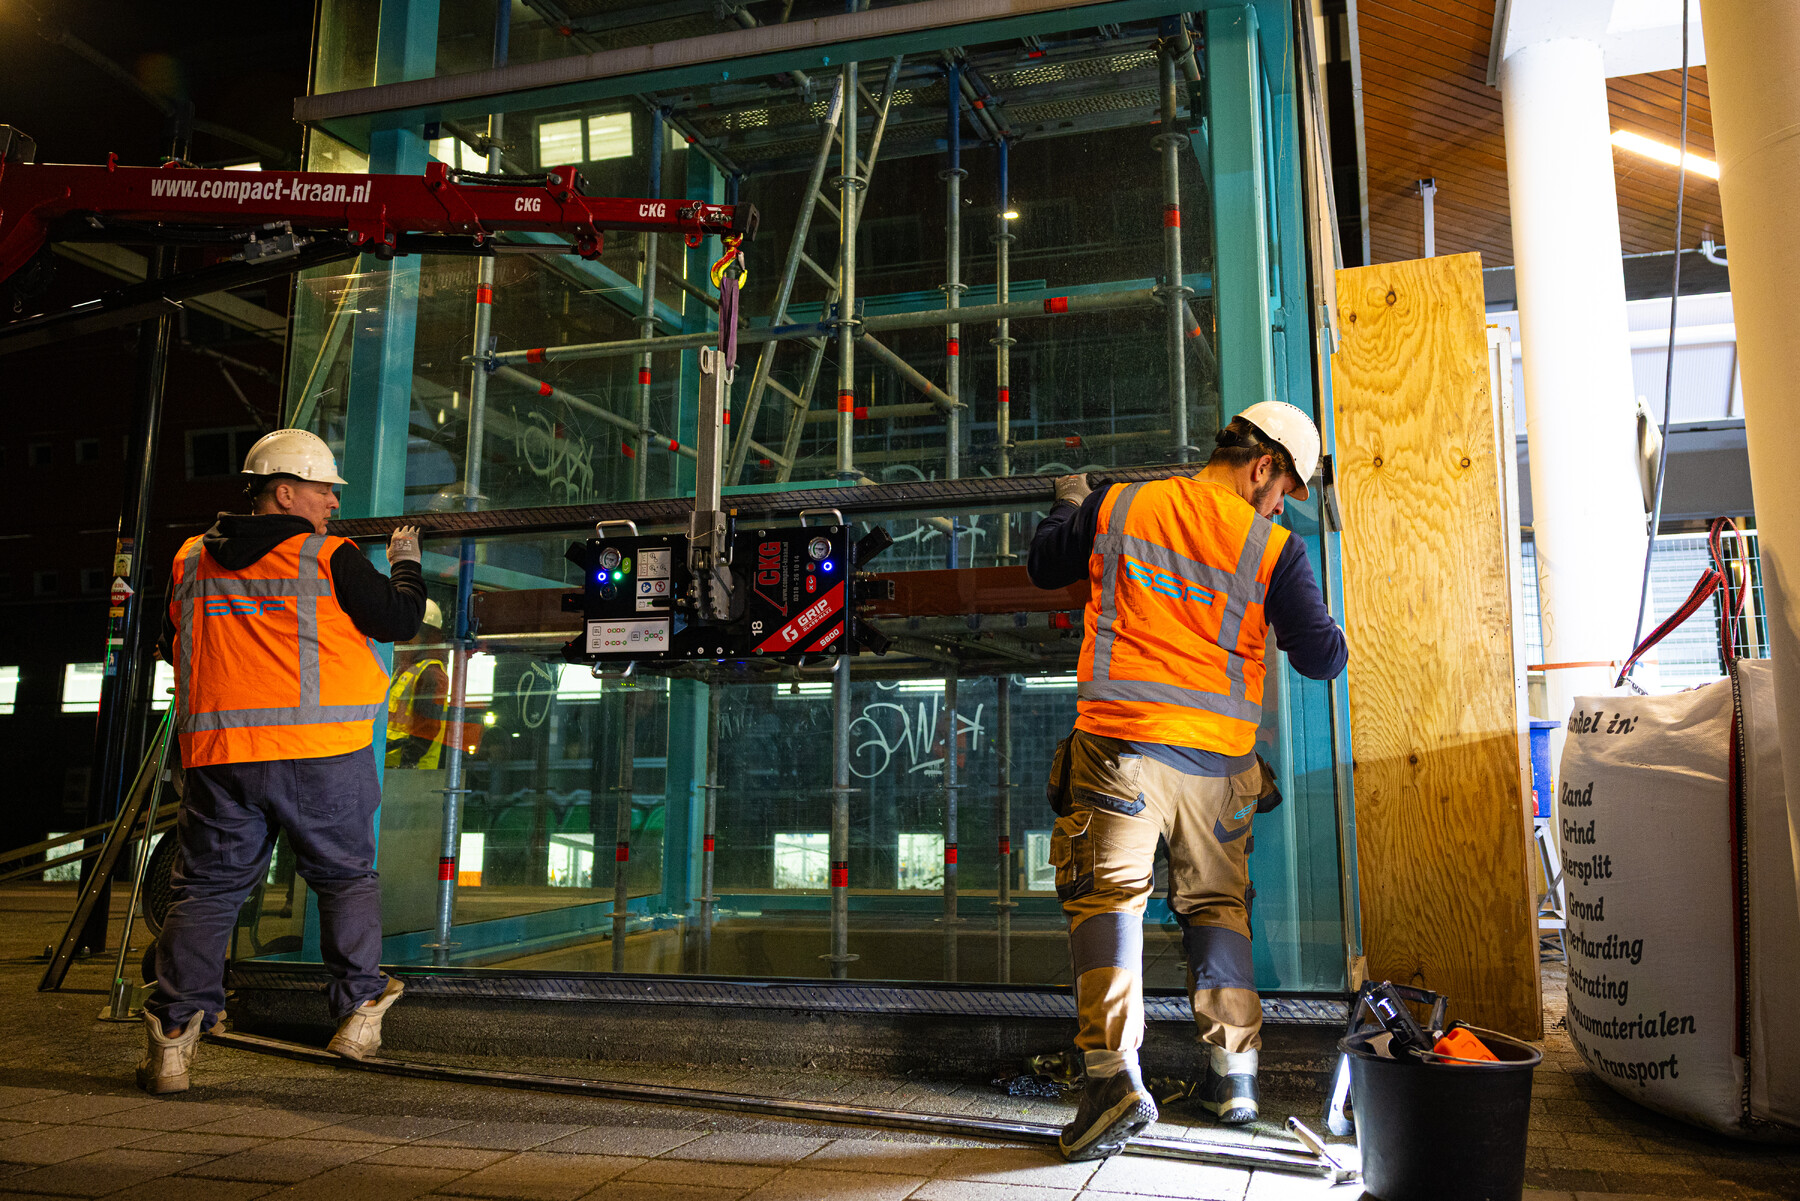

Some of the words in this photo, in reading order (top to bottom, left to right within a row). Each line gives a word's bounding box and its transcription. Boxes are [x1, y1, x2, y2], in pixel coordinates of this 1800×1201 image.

[151, 178, 372, 204] www.compact-kraan.nl
[514, 197, 541, 212] CKG
[639, 203, 666, 218] CKG
[758, 541, 781, 586] CKG
[1126, 561, 1215, 606] GSF
[204, 599, 285, 616] GSF
[798, 599, 828, 627] GRIP
[751, 620, 763, 637] 18
[1568, 710, 1603, 735] andel
[1607, 713, 1639, 735] in:
[1562, 781, 1594, 807] Zand
[1563, 818, 1596, 844] Grind
[1568, 892, 1604, 921] Grond
[1593, 1048, 1679, 1087] Transport
